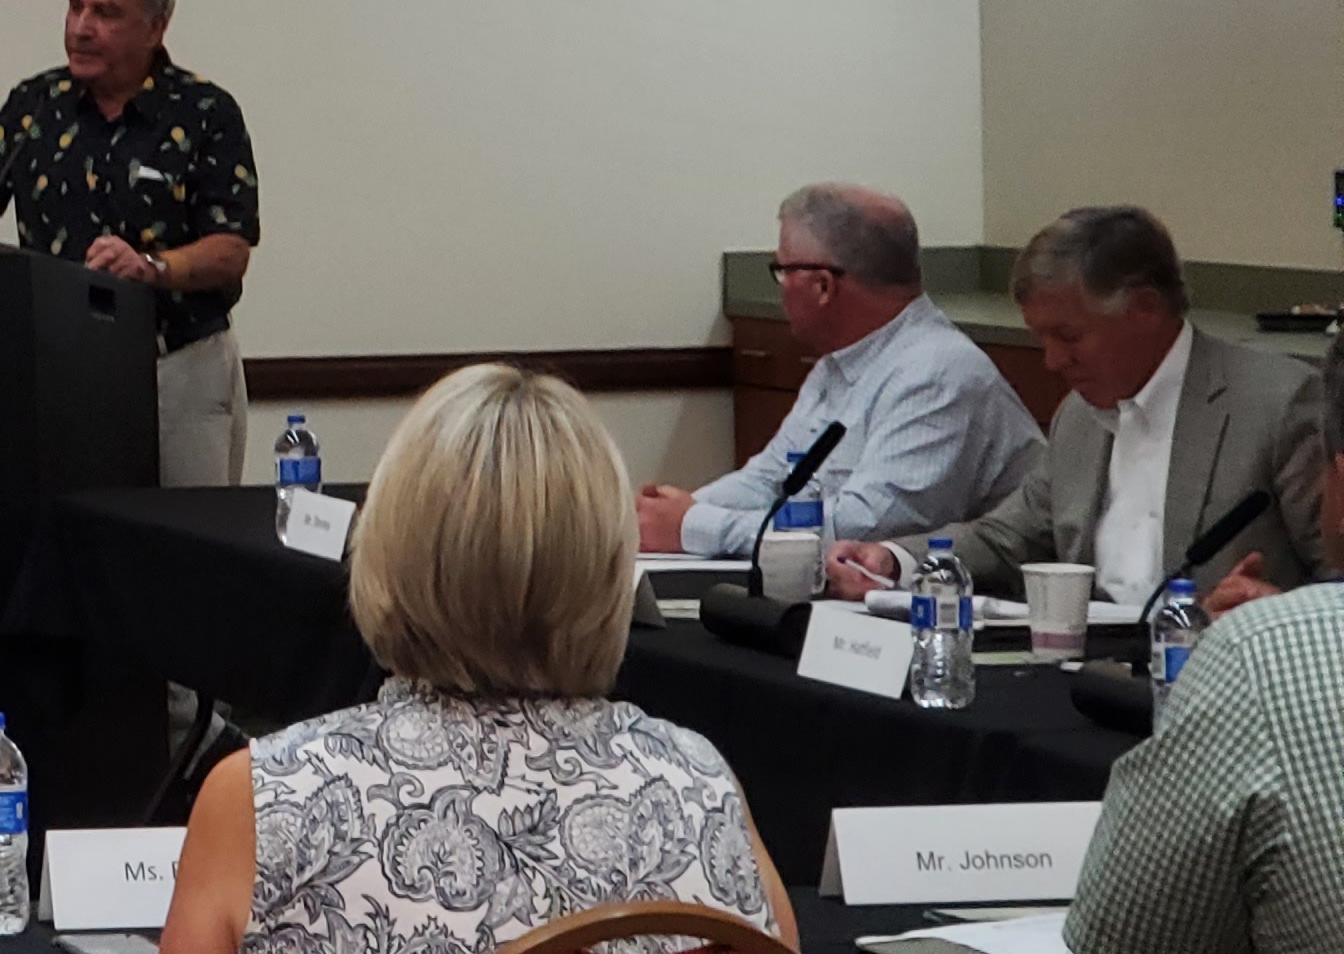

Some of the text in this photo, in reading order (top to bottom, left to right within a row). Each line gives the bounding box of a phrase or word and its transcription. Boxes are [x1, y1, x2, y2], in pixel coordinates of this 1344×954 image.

[916, 850, 1052, 871] Mr. Johnson
[125, 862, 163, 881] Ms.
